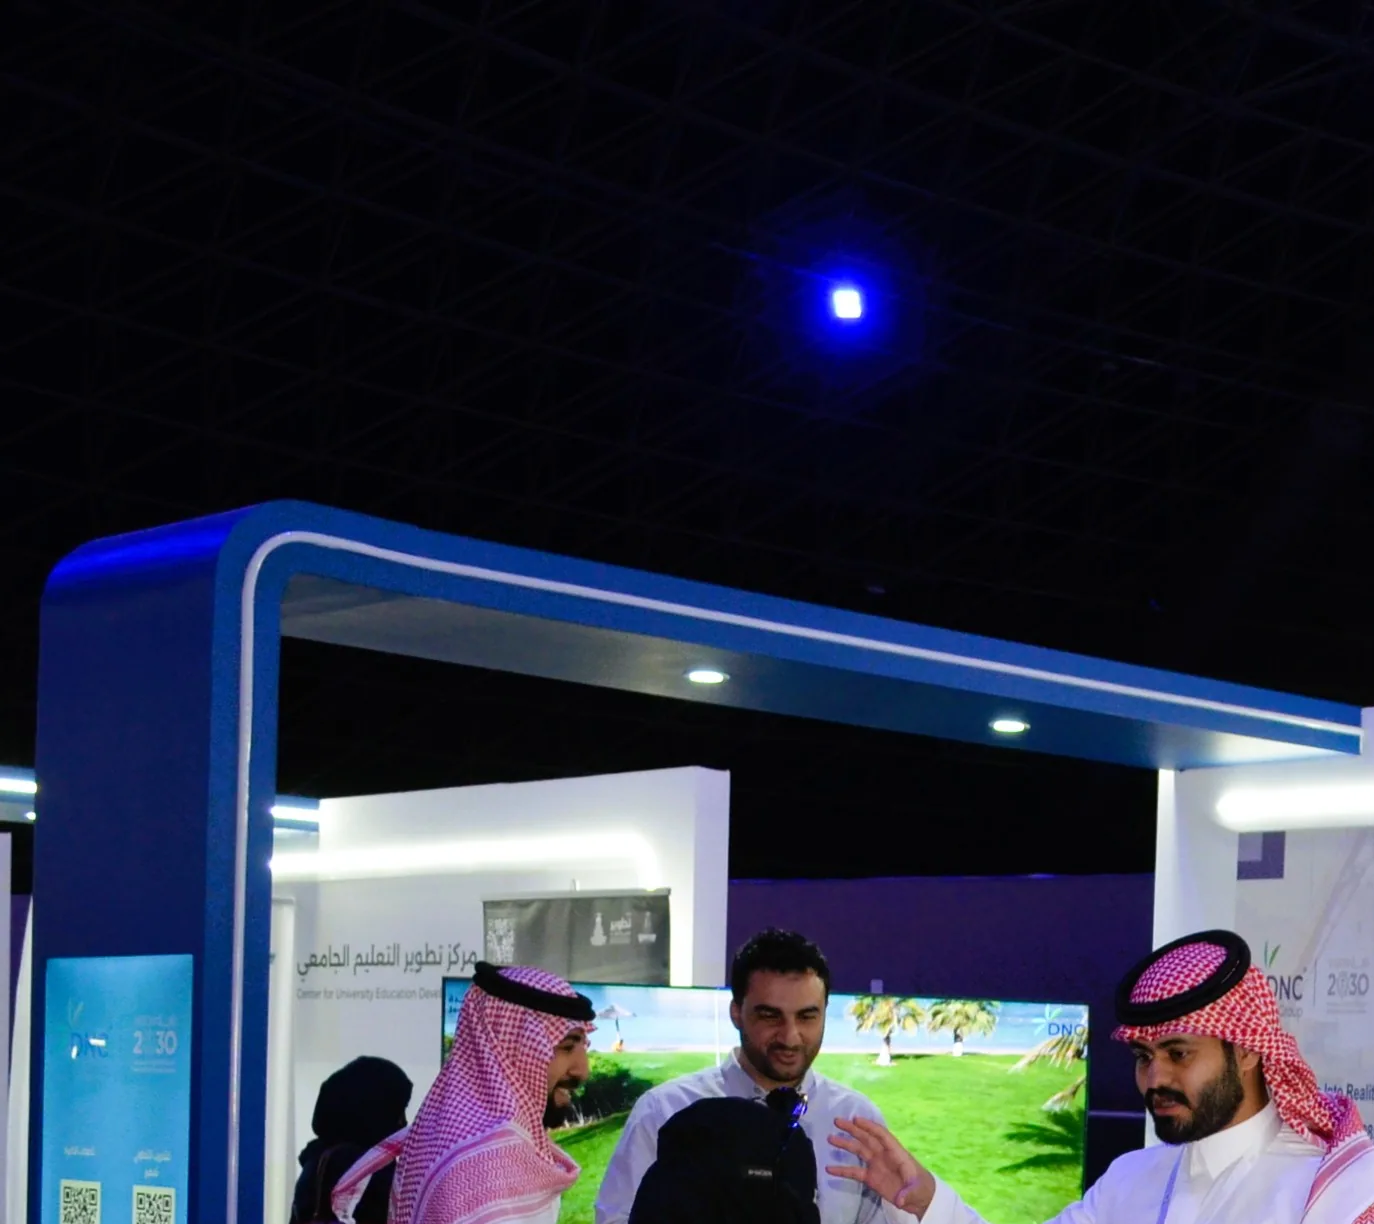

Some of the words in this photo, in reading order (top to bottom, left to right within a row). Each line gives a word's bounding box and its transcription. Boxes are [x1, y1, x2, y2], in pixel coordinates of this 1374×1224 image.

[297, 944, 349, 983] الجامعي
[353, 942, 400, 976] التعليم
[404, 942, 443, 973] تطوير
[446, 942, 477, 973] مركز
